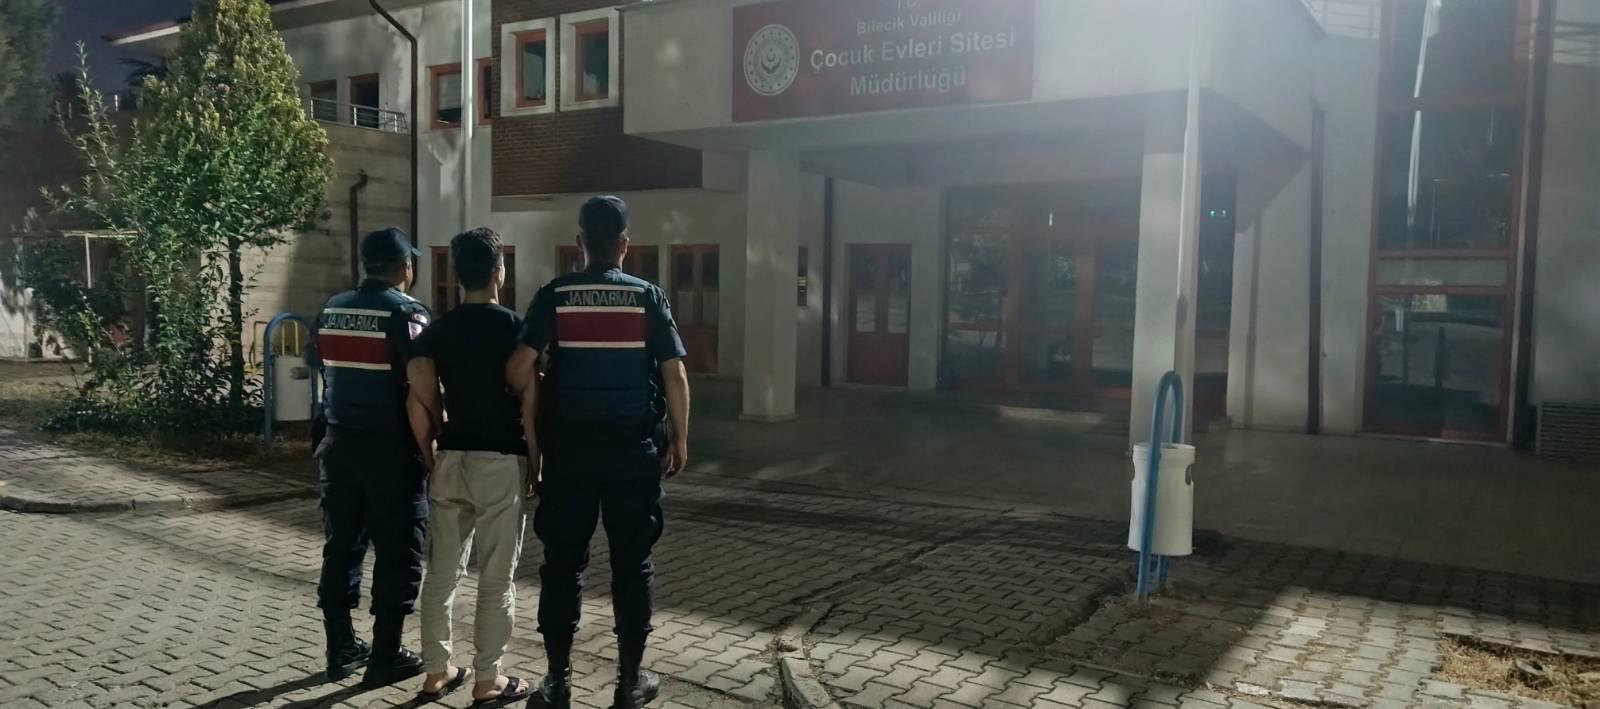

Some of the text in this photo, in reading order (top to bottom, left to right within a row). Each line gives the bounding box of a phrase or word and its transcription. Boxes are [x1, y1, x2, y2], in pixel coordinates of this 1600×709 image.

[856, 7, 961, 35] Bilecik Valiliği
[810, 44, 874, 72] Çocuk
[881, 35, 943, 61] Evleri
[951, 25, 1016, 53] Sitesi
[850, 65, 966, 97] Müdürlüğü
[565, 290, 637, 306] JANDARMA
[324, 313, 379, 332] JANDARMA
